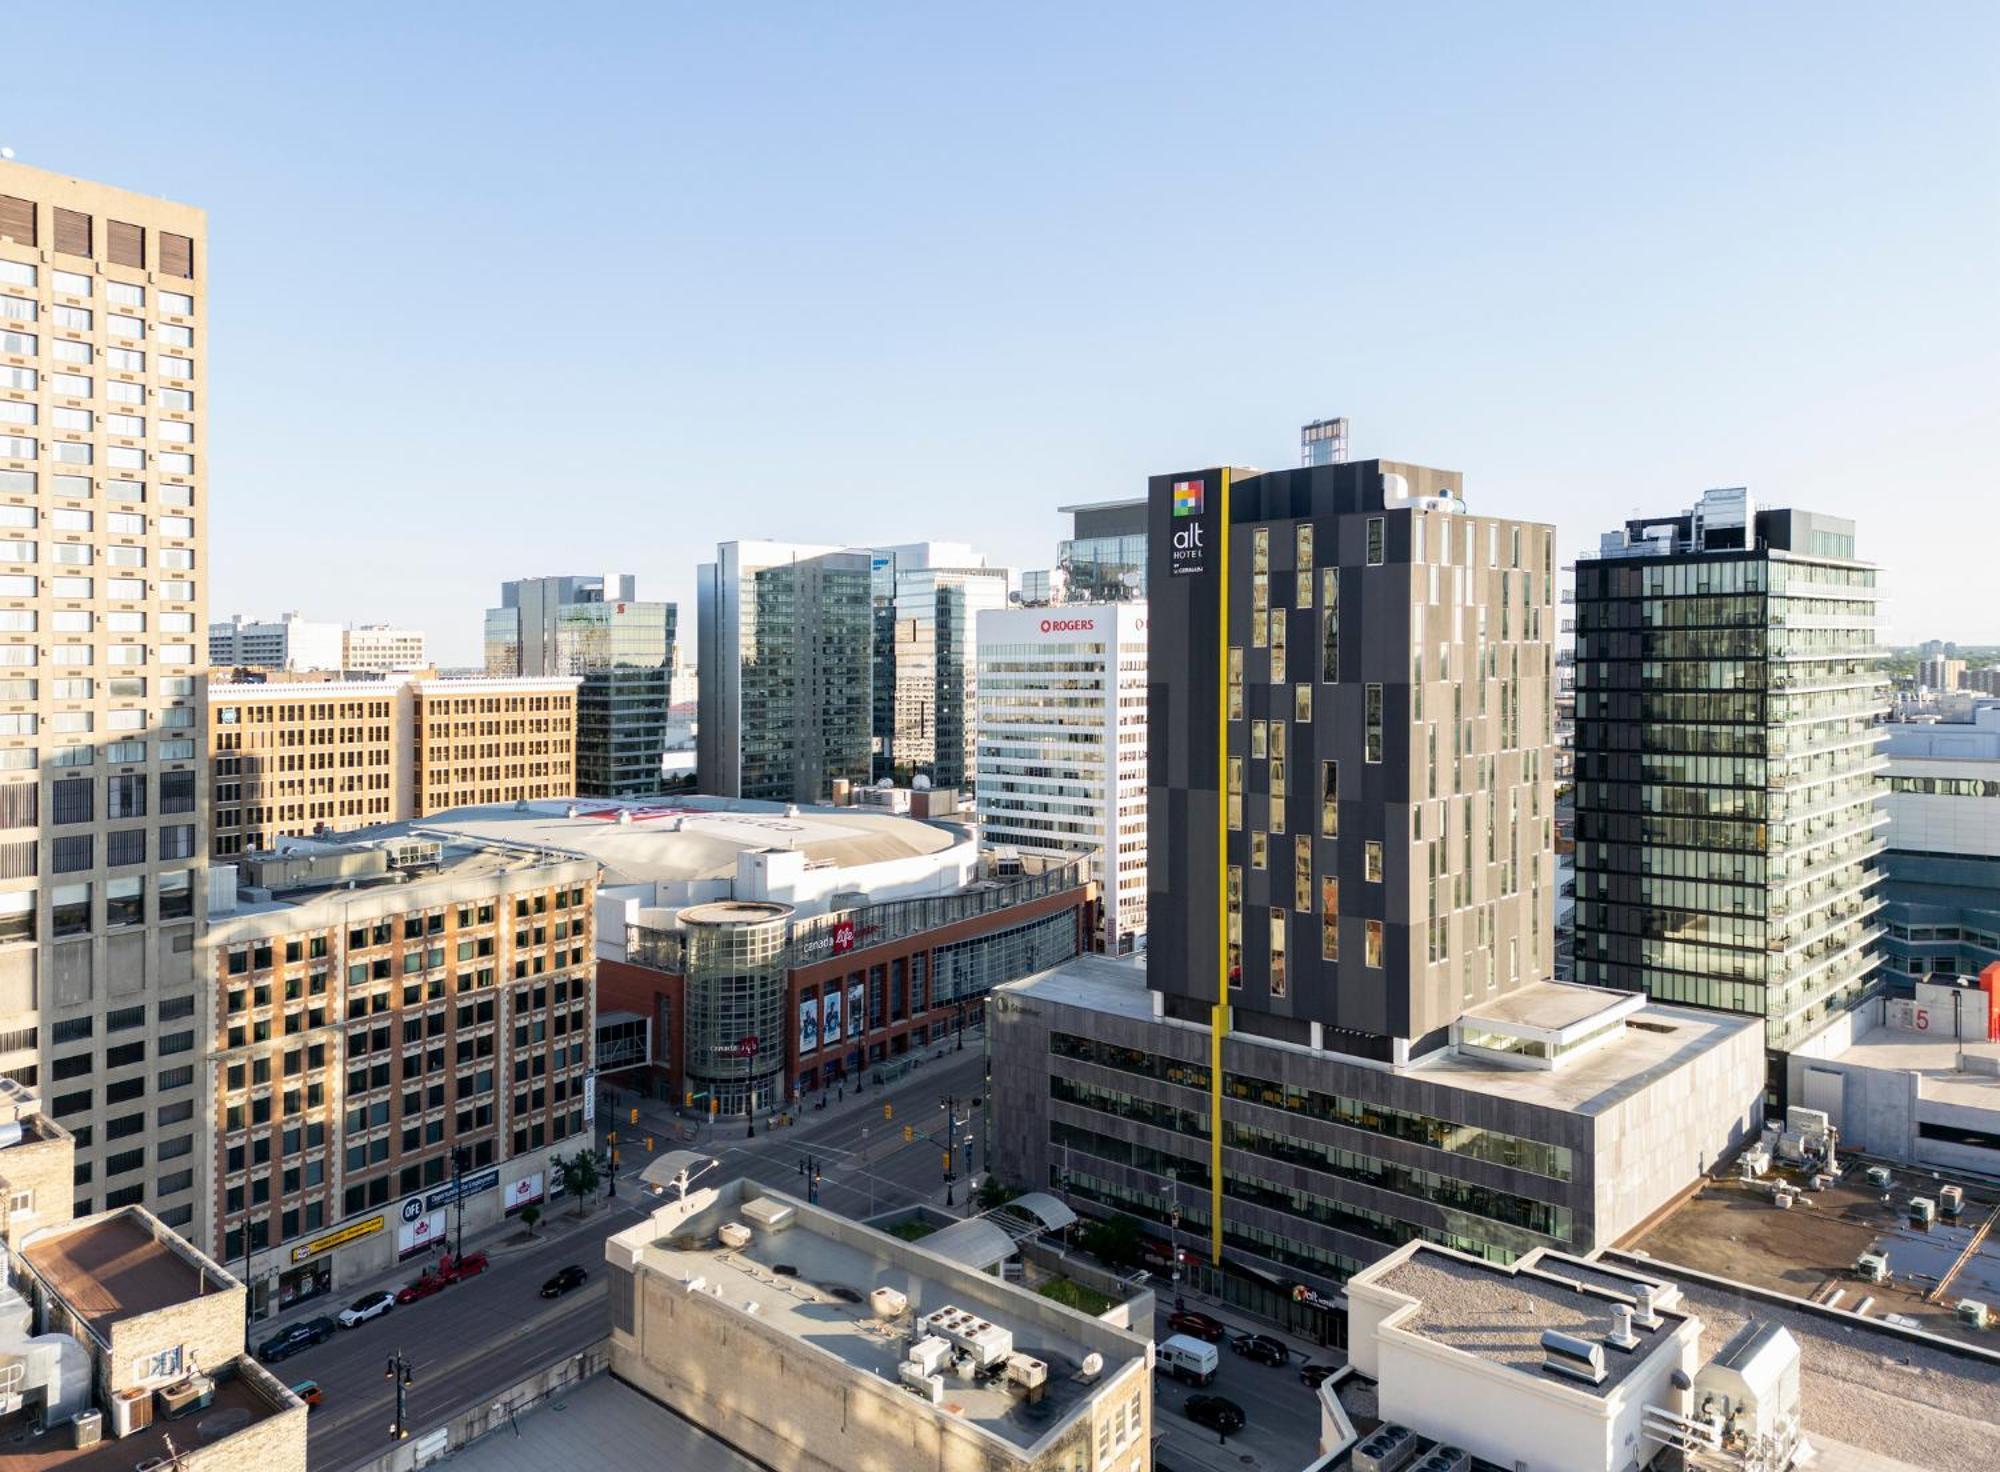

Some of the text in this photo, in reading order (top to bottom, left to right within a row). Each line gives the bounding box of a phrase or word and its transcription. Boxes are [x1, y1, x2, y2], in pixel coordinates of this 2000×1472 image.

[1173, 522, 1203, 549] alt
[1173, 550, 1202, 559] HOTEL
[1053, 619, 1094, 632] ROGERS
[803, 935, 834, 953] canada
[835, 927, 854, 948] life
[1916, 1009, 1928, 1030] 5
[404, 1202, 420, 1218] OFE
